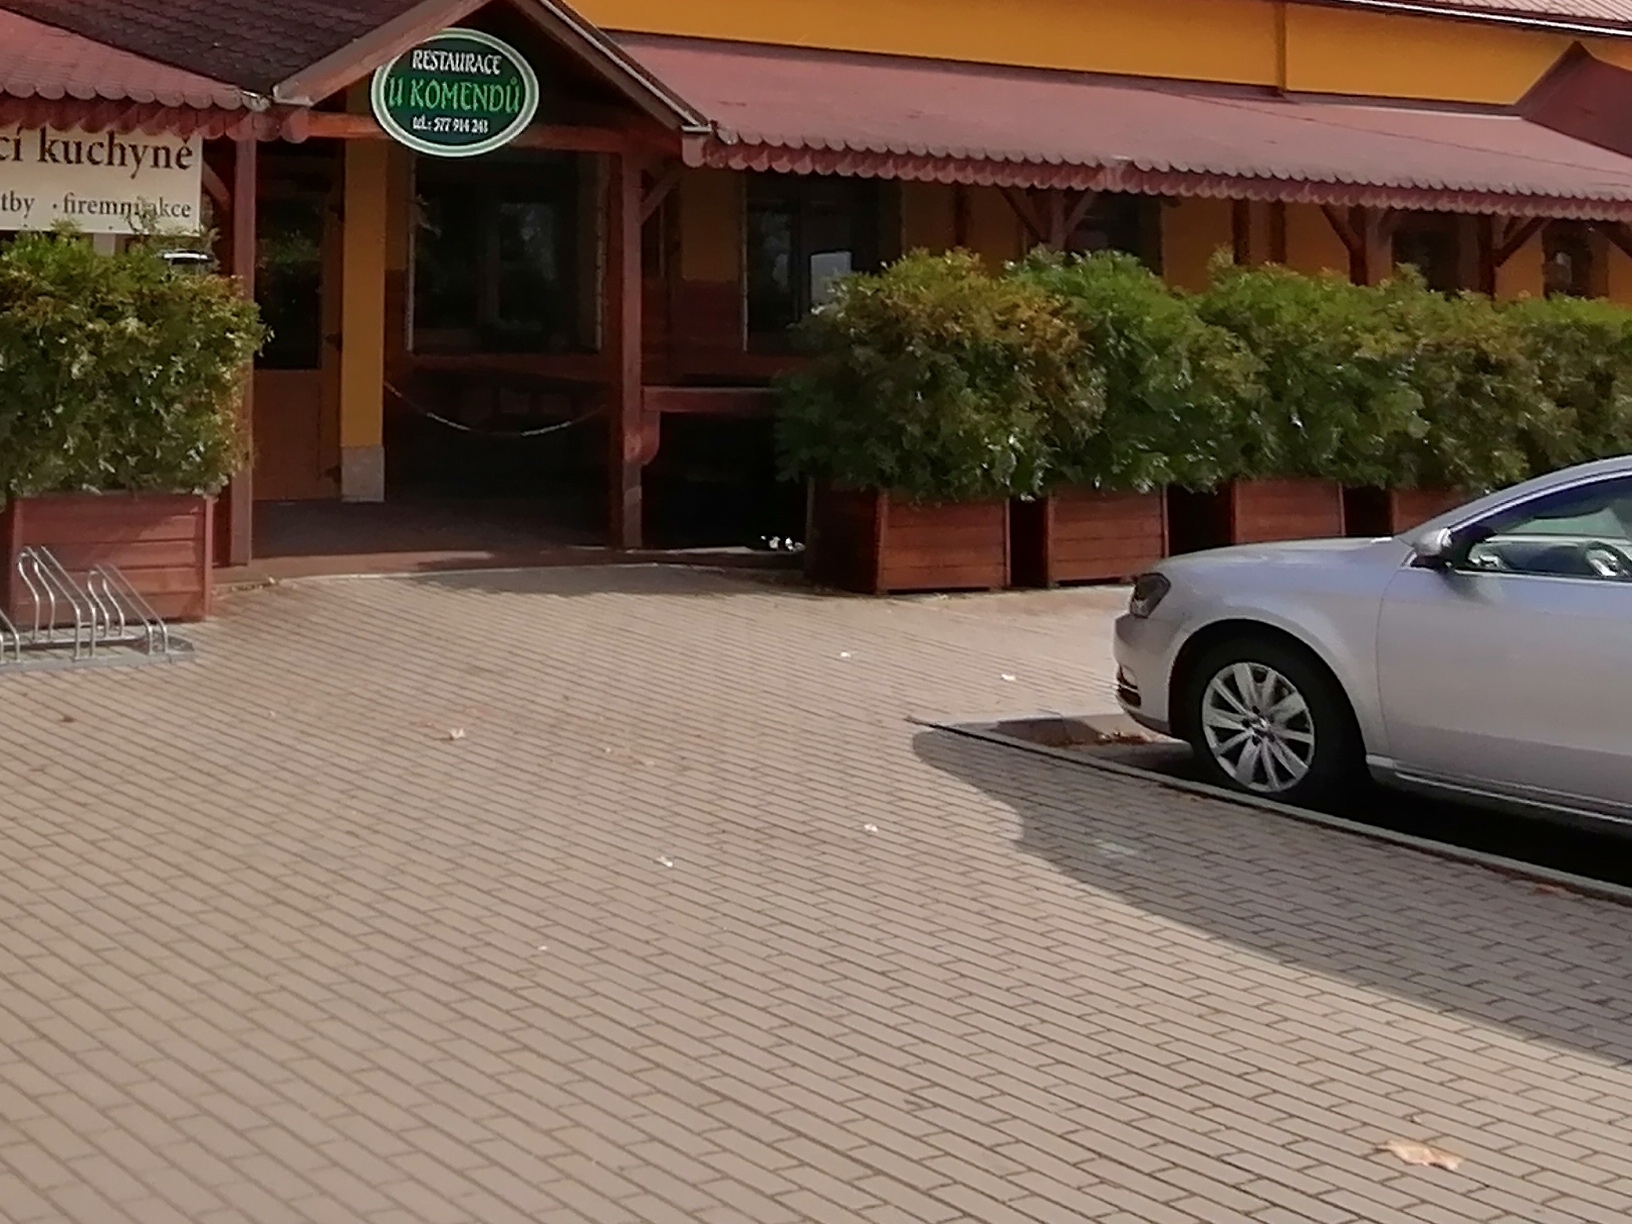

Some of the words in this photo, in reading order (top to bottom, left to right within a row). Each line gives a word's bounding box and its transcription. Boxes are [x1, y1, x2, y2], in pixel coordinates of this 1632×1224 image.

[412, 49, 502, 75] RESTAURACE
[388, 78, 404, 108] U
[410, 77, 520, 114] KOMENDŮ
[433, 117, 452, 132] 577
[37, 125, 194, 180] kuchyně
[148, 196, 191, 218] akce
